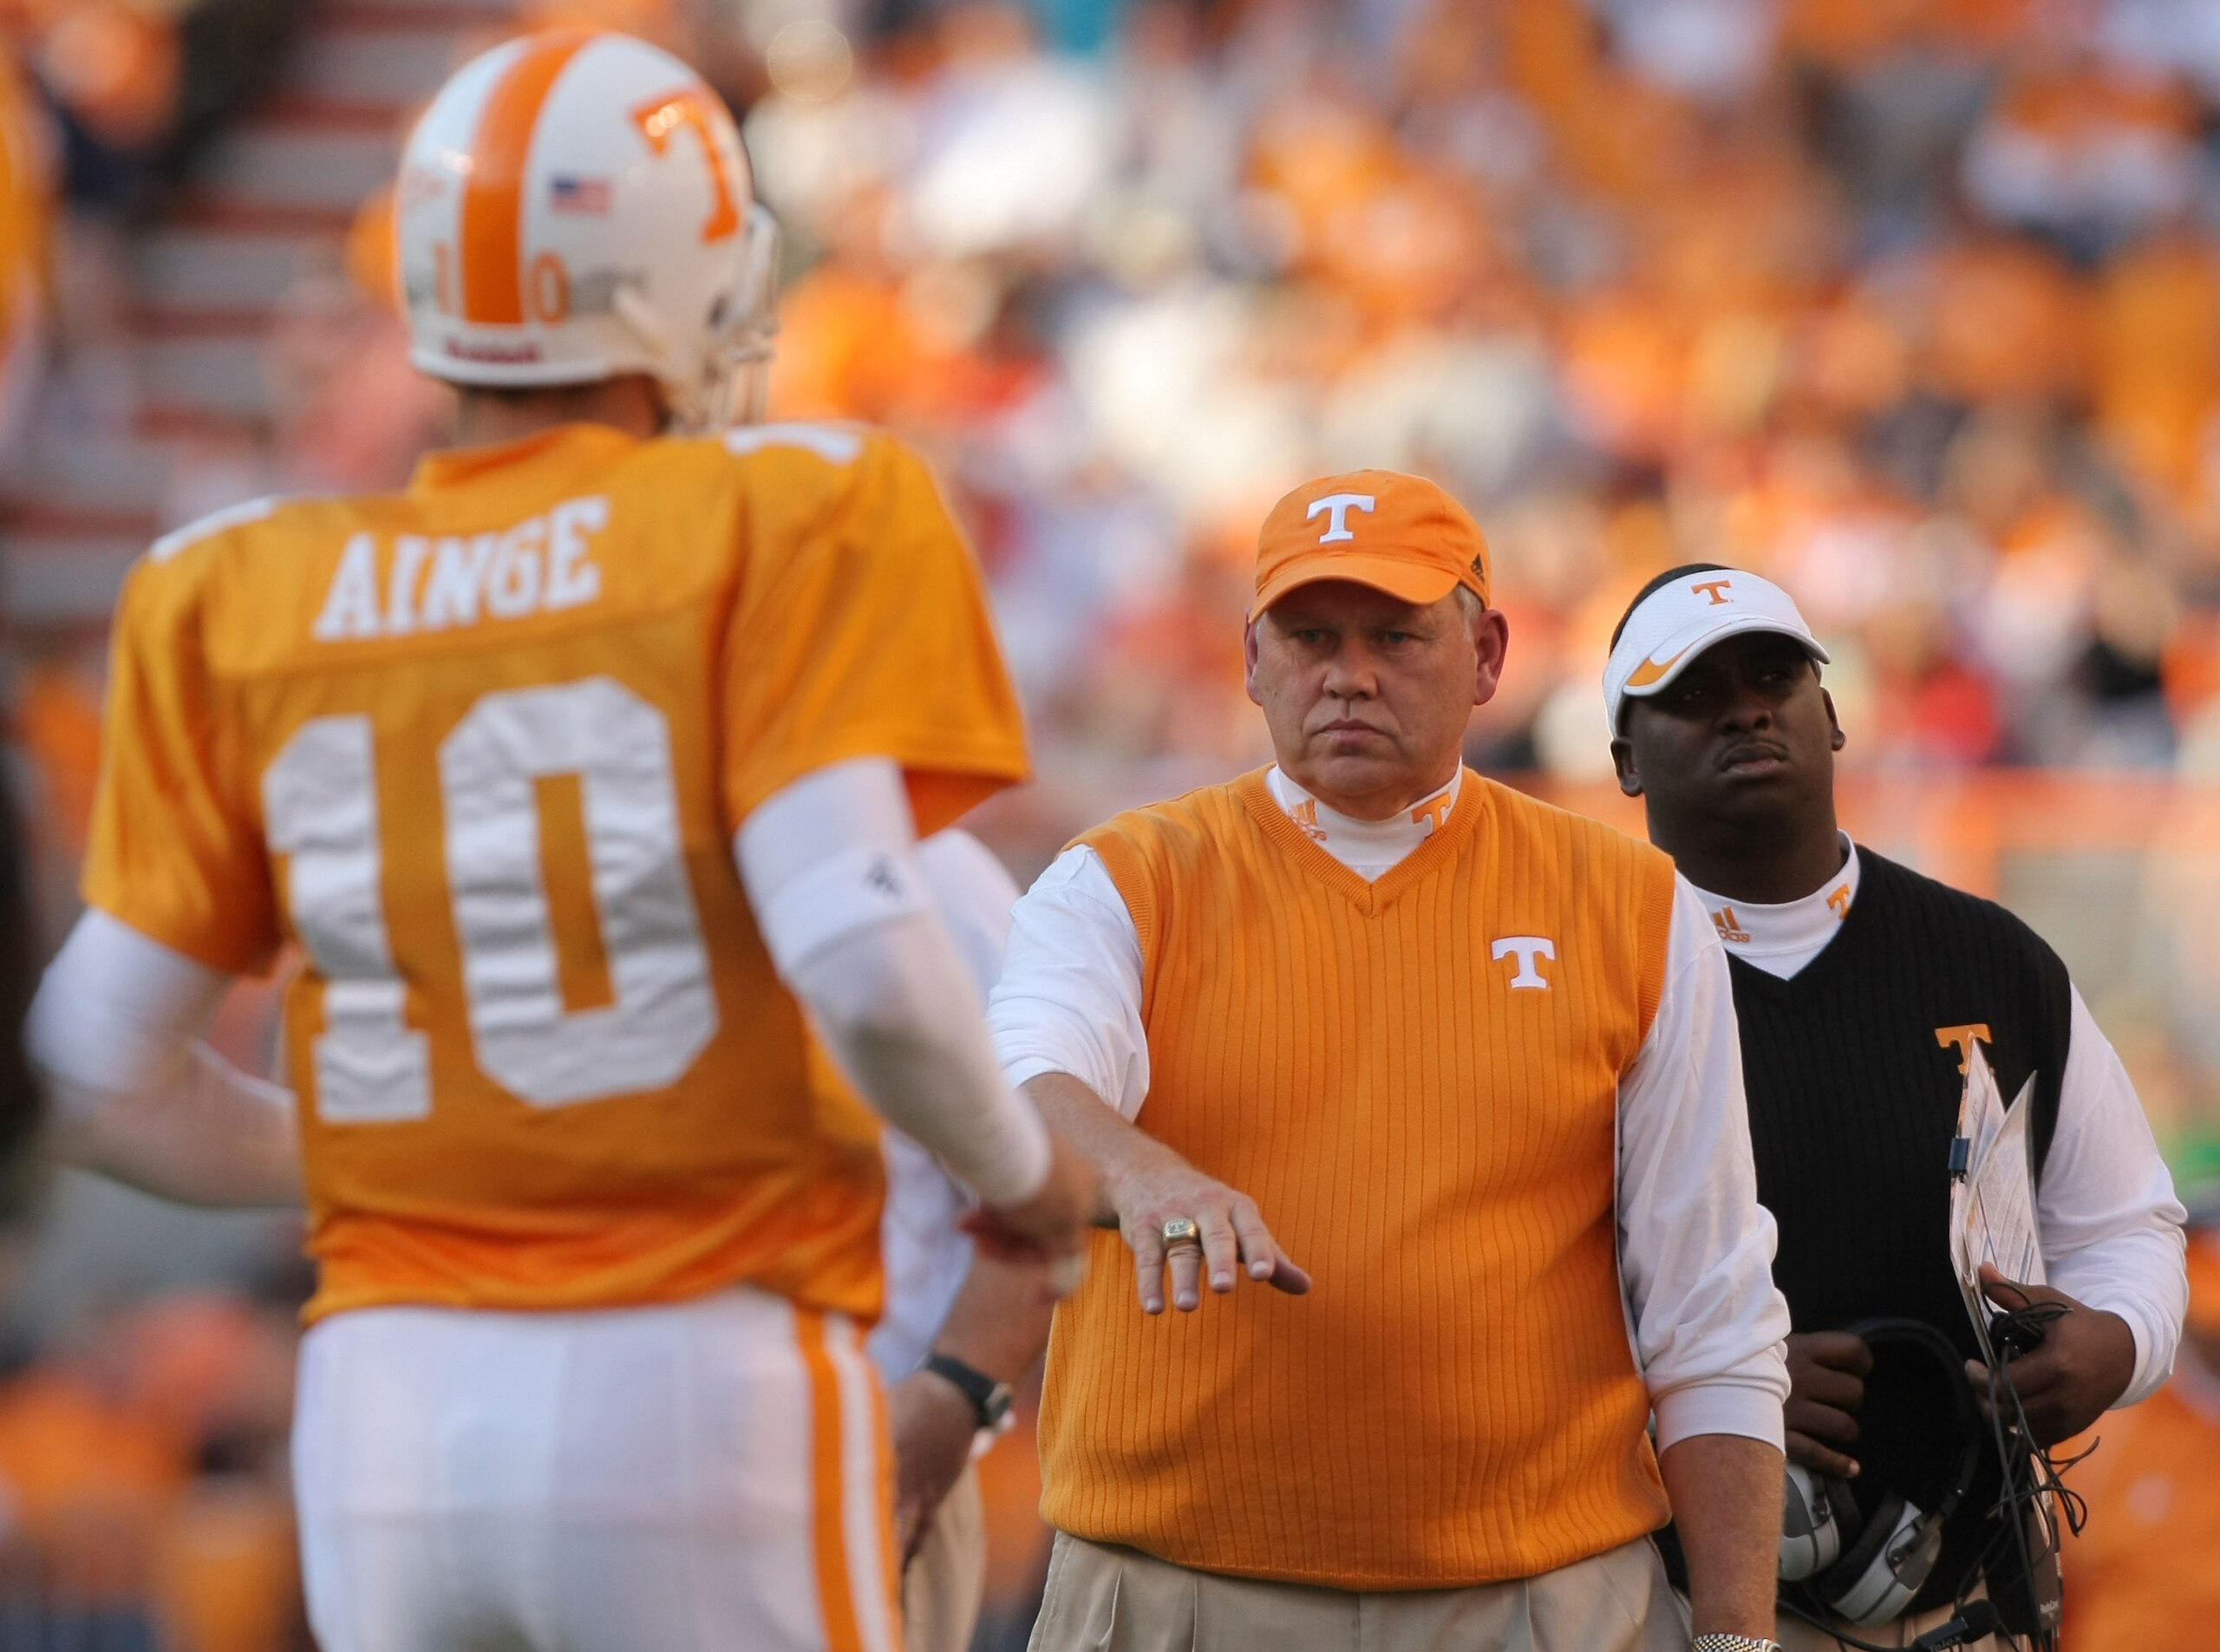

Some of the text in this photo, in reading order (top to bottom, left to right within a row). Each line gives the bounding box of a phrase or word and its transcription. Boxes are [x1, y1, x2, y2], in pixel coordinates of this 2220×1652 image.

[630, 88, 741, 242] T
[1306, 493, 1375, 544] T
[313, 495, 610, 642] AINGE
[1691, 579, 1732, 606] T
[1411, 790, 1451, 840] T
[260, 674, 721, 1125] 10
[1491, 936, 1557, 990] T
[1934, 1023, 1994, 1075] T
